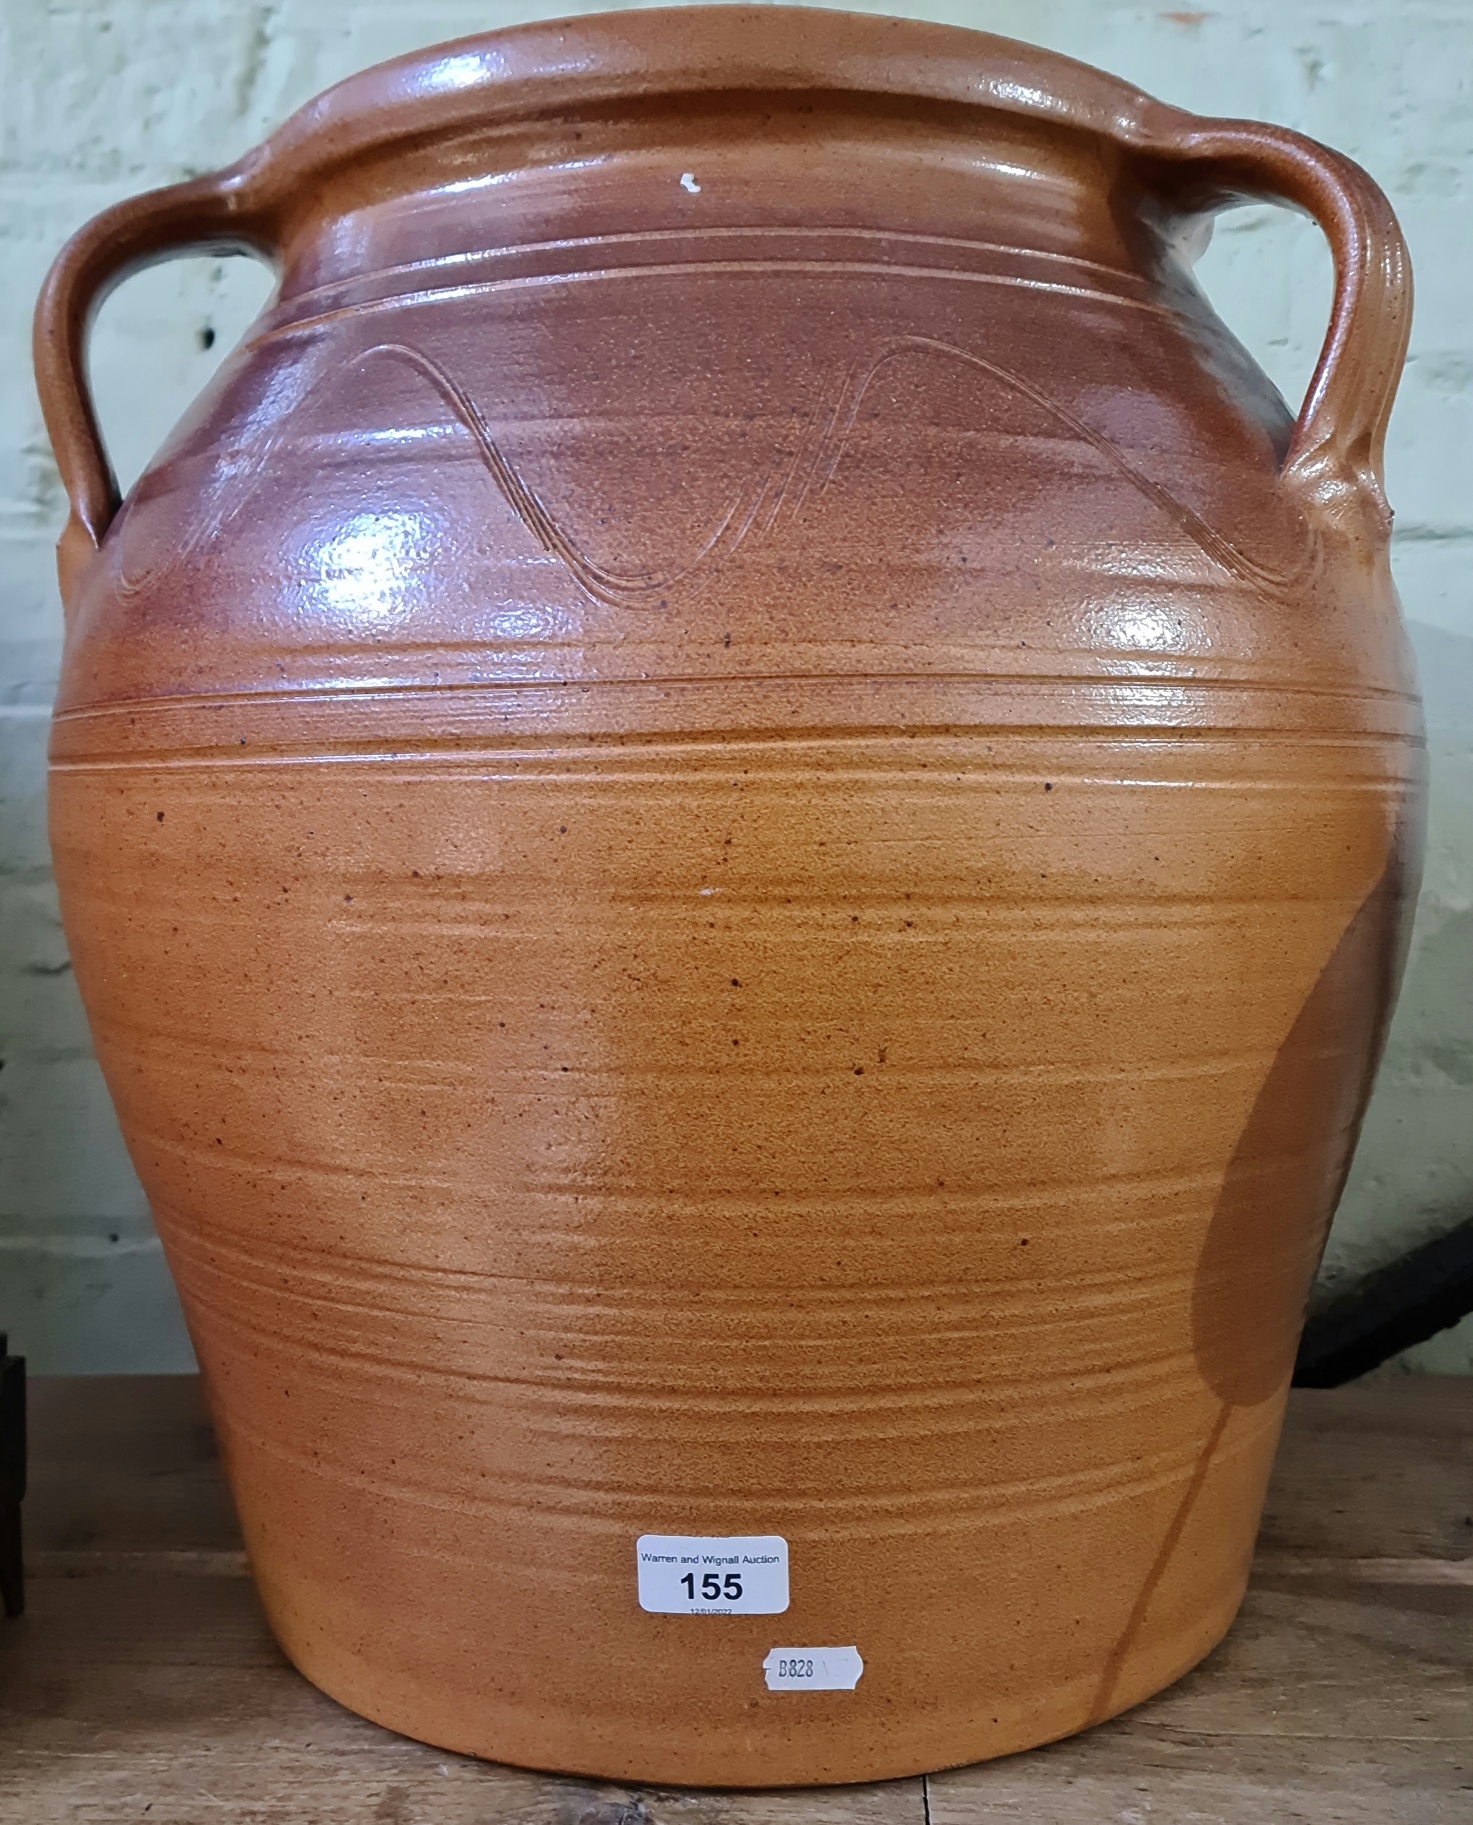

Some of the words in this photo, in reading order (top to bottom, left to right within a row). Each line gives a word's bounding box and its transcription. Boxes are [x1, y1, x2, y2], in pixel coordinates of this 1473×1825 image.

[641, 1553, 677, 1563] Warren
[681, 1555, 699, 1564] and
[702, 1555, 739, 1566] Wignall
[742, 1555, 780, 1564] Auction
[680, 1572, 743, 1600] 155
[778, 1659, 814, 1678] B828
